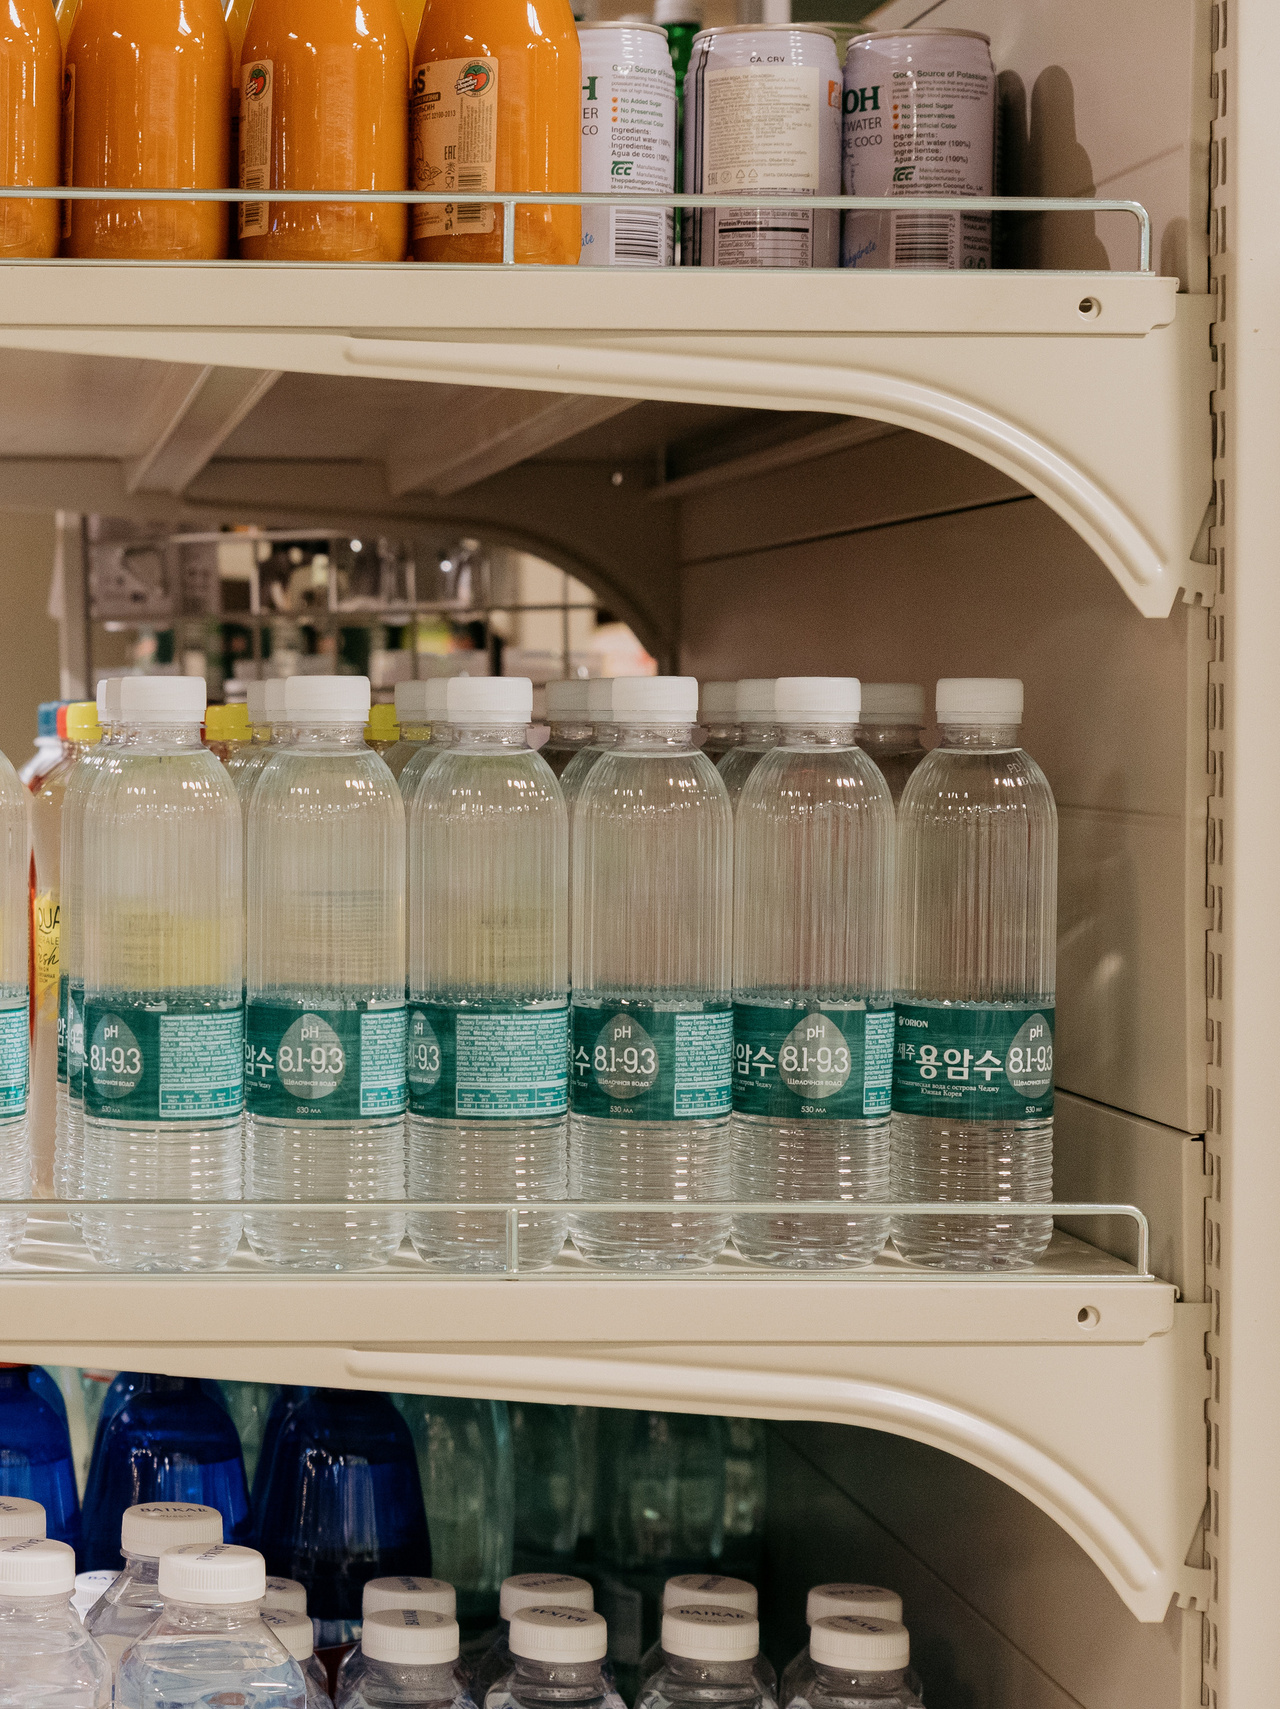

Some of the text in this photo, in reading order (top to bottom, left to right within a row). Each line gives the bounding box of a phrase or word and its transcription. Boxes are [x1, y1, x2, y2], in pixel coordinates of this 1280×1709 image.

[854, 134, 882, 148] COCO
[949, 140, 971, 149] (100%)
[894, 148, 941, 156] Ingreientes:
[905, 1018, 928, 1028] ORION
[104, 1025, 119, 1040] pH
[301, 1026, 319, 1041] pH
[614, 1026, 631, 1041] pH
[806, 1026, 825, 1041] pH
[1030, 1025, 1043, 1041] pH
[90, 1044, 141, 1074] 8.1~9.3
[279, 1046, 343, 1074] 8.1~9.3
[594, 1045, 656, 1074] 8.1~9.3
[782, 1046, 848, 1073] 8.1~9.3
[897, 1042, 1004, 1081] 제주 용암수
[1009, 1045, 1052, 1073] 8.1~9.3
[921, 1088, 962, 1098] Южная Корея
[978, 1084, 1000, 1093] Чеджу
[1, 1538, 45, 1553] BAIKAL
[531, 1608, 586, 1622] BAIKAL
[680, 1610, 744, 1618] BAIKAL
